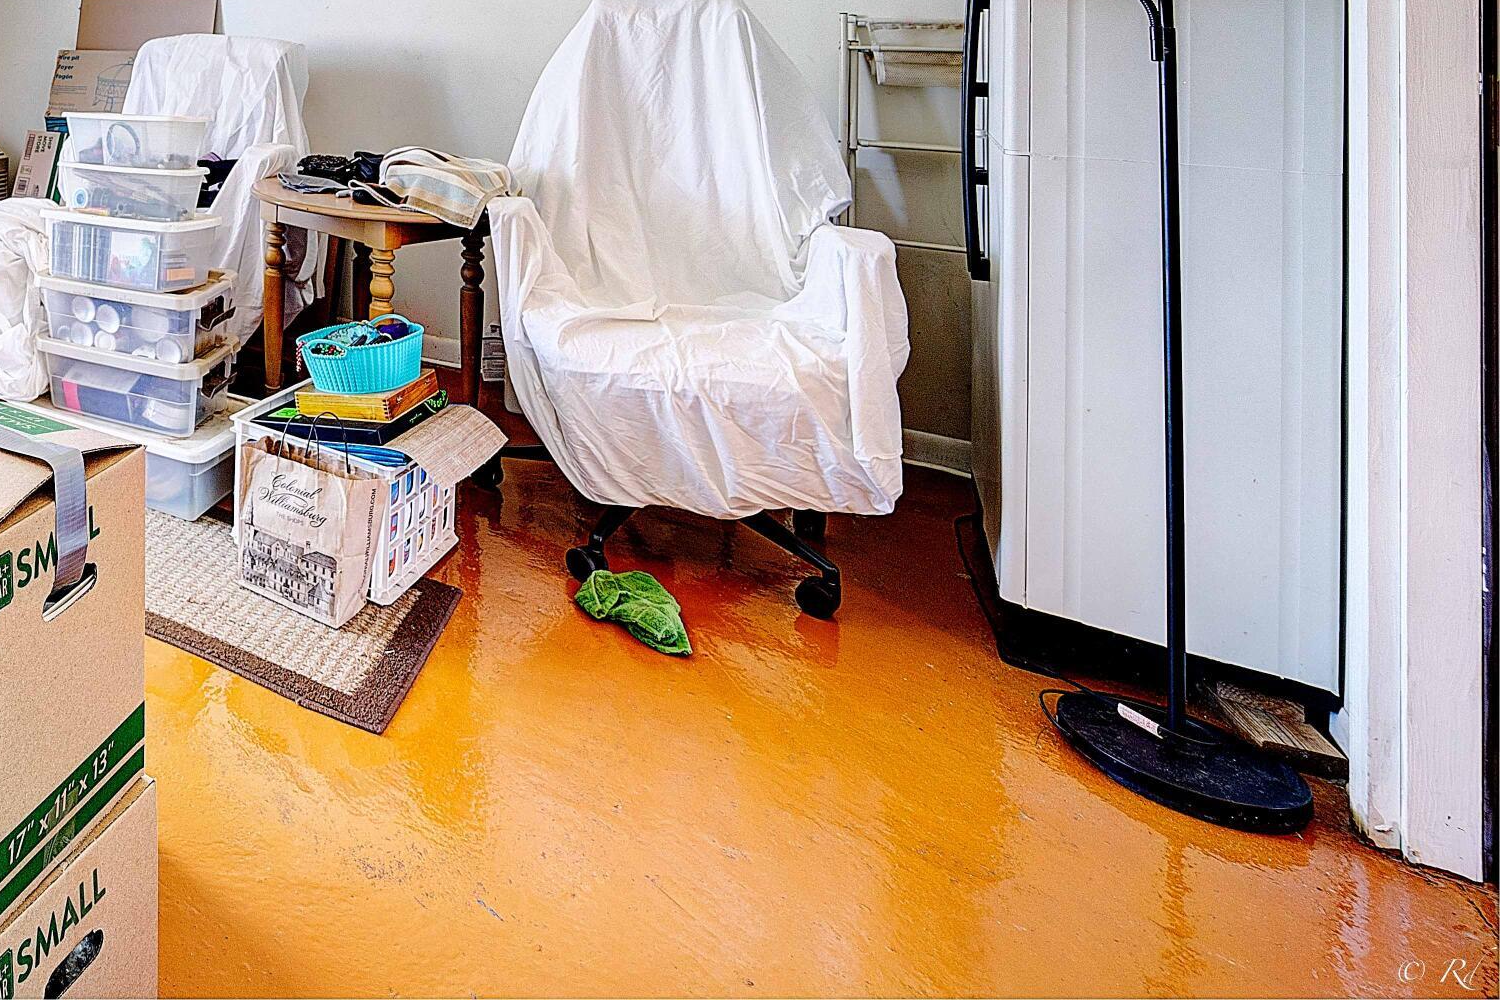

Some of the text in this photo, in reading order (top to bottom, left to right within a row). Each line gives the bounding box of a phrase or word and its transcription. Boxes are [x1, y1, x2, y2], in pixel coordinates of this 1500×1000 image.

[34, 135, 42, 153] STORE
[40, 136, 48, 153] MOVE
[259, 486, 328, 528] Williamsburg
[271, 472, 323, 500] Colonial
[16, 505, 101, 588] SML
[8, 740, 115, 866] 17" x 11" x 13"
[16, 867, 107, 984] SMALL
